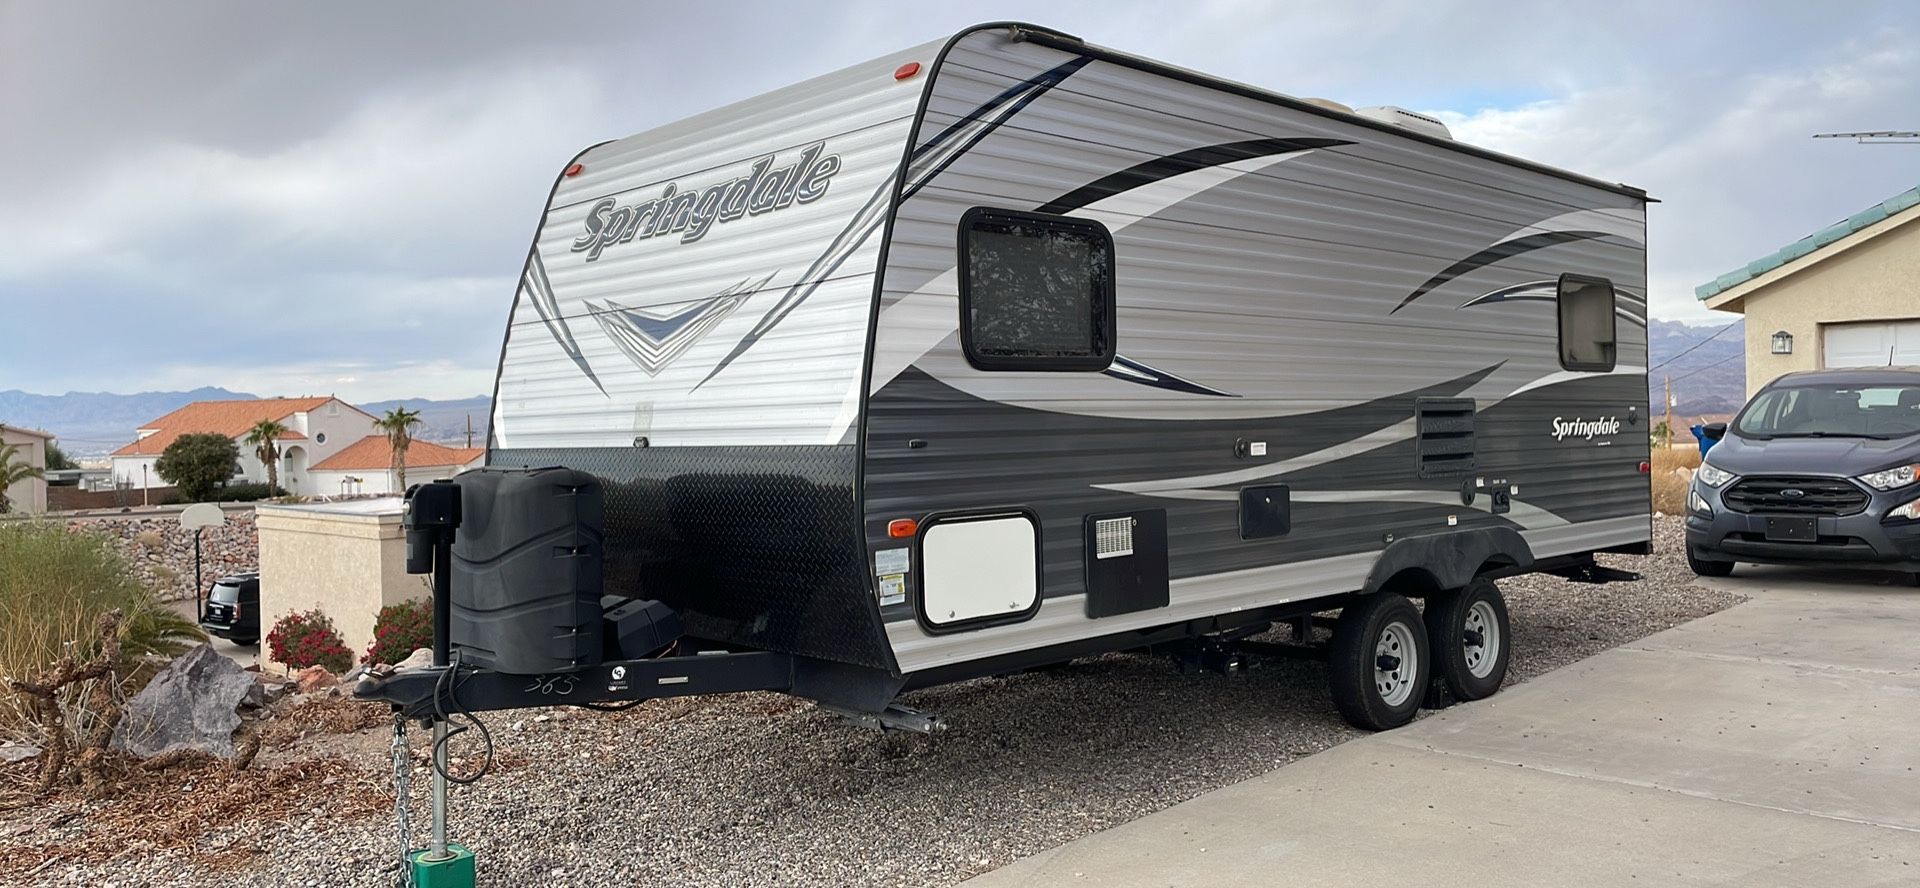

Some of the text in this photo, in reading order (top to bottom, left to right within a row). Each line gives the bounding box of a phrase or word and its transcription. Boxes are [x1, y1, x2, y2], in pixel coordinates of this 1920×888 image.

[570, 140, 841, 262] Springdale
[1552, 416, 1620, 441] Springdale
[524, 674, 579, 694] 365
